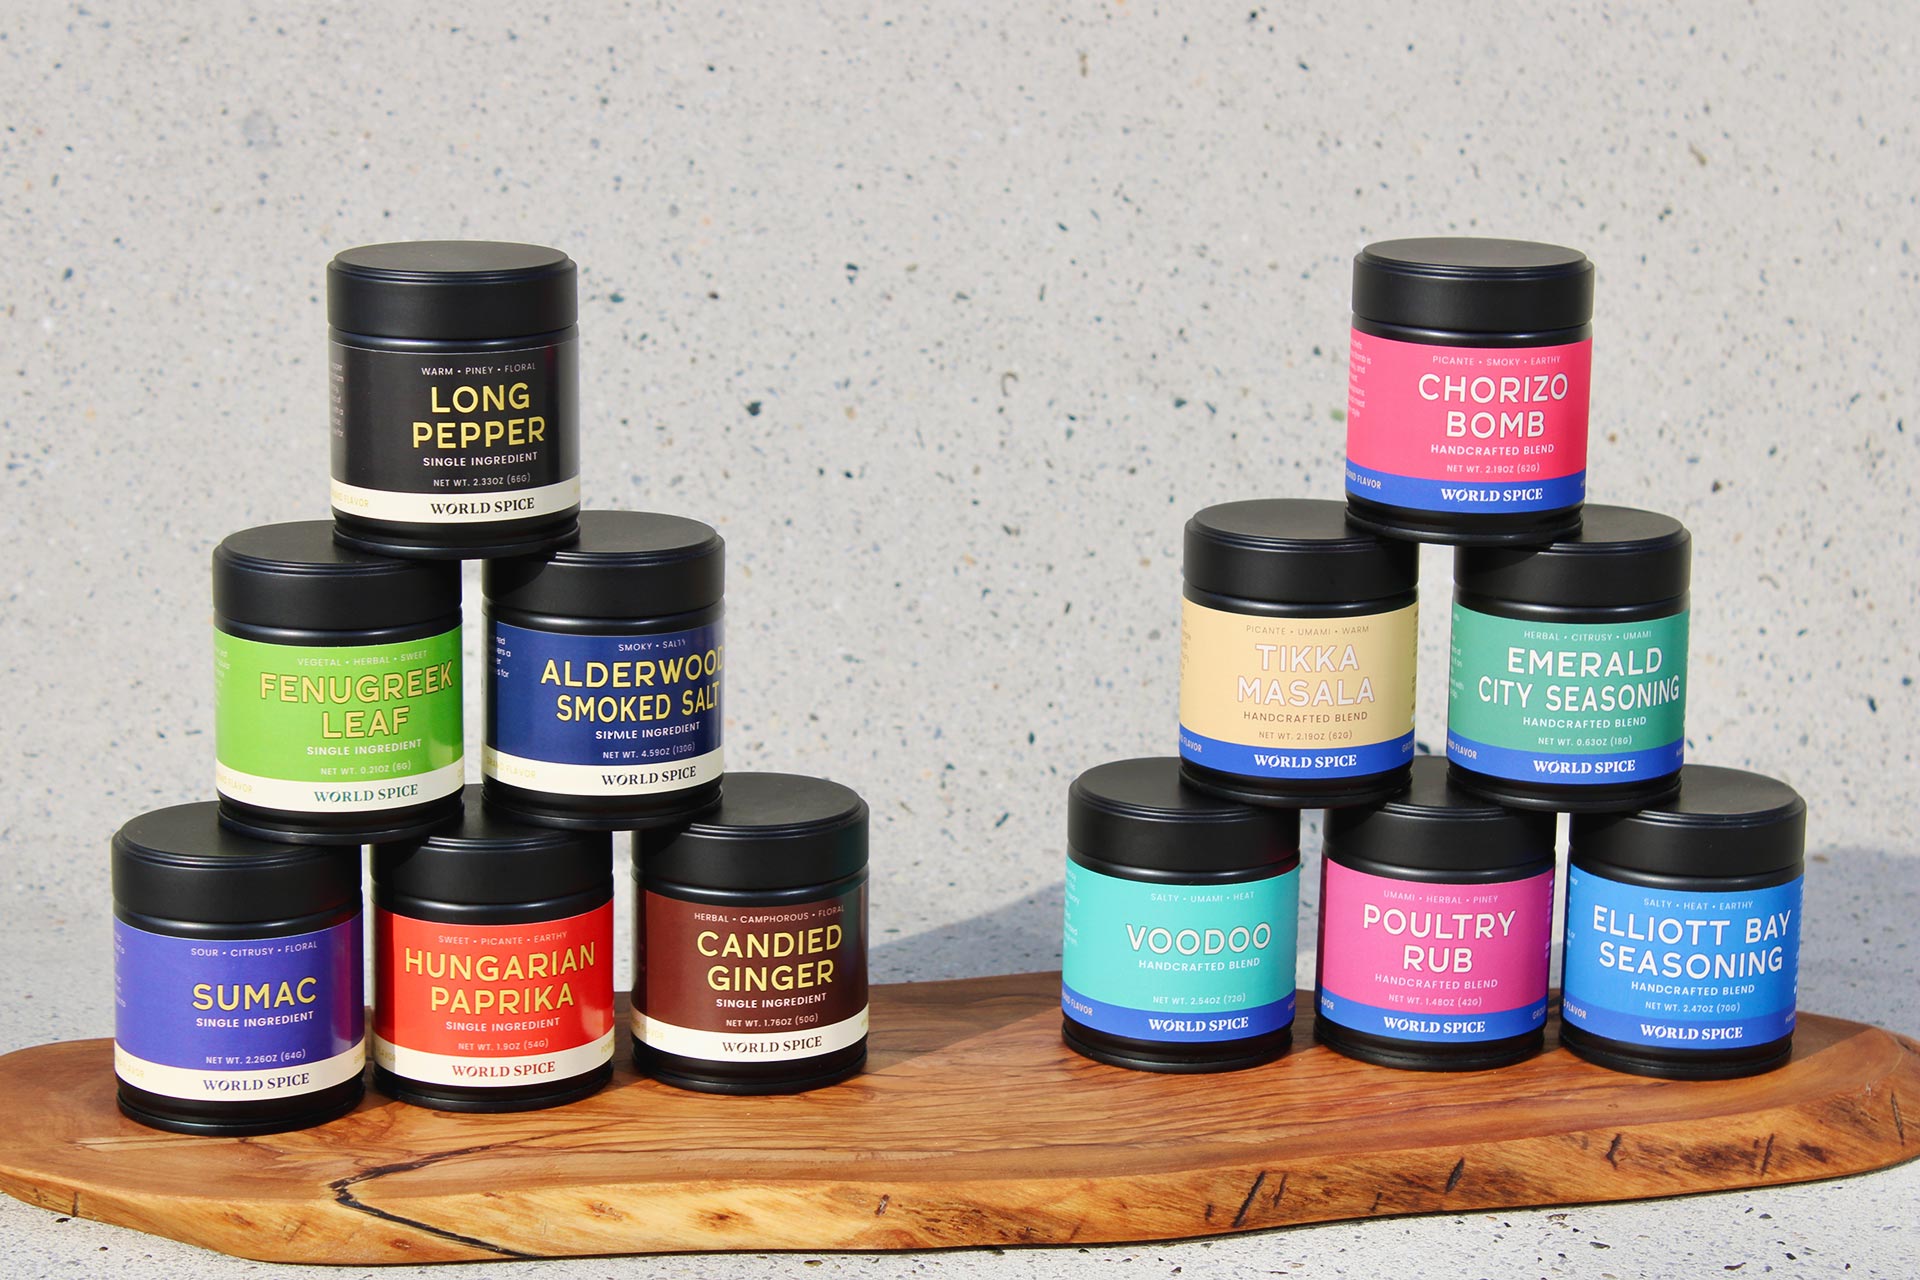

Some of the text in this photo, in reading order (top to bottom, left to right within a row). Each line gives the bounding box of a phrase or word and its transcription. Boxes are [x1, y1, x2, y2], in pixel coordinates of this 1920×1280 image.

[1432, 355, 1561, 366] PICANTE SMOKY EARTHY
[421, 362, 536, 376] WARM PINEY FLORAL
[1418, 372, 1569, 404] CHORIZO
[431, 382, 531, 414] LONG
[412, 416, 546, 449] PEPPER
[1446, 411, 1546, 439] BOMB
[1431, 444, 1555, 455] HANDCRAFTED BLEND
[423, 452, 538, 467] SINGLE INGREDIENT
[1447, 463, 1540, 473] NET WT. (62G)
[433, 473, 531, 487] NET WT. 2.33OZ (66G)
[1357, 474, 1381, 490] FLAVOR
[1503, 487, 1543, 501] SPICE
[494, 497, 535, 512] SPICE
[1246, 625, 1369, 636] PICANTE UMAMI WARM
[1524, 631, 1652, 641] HERBAL CITRUSY UMAMI
[618, 643, 652, 651] SMOKY
[297, 651, 428, 667] VEGETAL HERBAL SWEET
[1255, 643, 1360, 672] TIKKA
[1507, 646, 1663, 677] EMERALD
[540, 646, 724, 688] ALDERWOOD
[260, 660, 453, 704] FENUGREEK
[1237, 676, 1375, 707] MASALA
[1478, 675, 1680, 712] CITY SEASONING
[556, 683, 720, 723] SMOKED SALT
[322, 706, 410, 739] LEAF
[1244, 711, 1368, 723] HANDCRAFTED BLEND
[1523, 716, 1646, 729] HANDCRAFTED BLEND
[642, 721, 700, 738] INGREDIENT
[1259, 730, 1352, 741] NET WT. 2.19OZ (62G)
[307, 739, 422, 756] SINGLE INGREDIENT
[1538, 736, 1632, 747] NET WT. (18G)
[603, 748, 670, 759] NET WT. 4.59OZ
[1455, 744, 1477, 759] FLAVOR
[1317, 754, 1356, 768] SPICE
[1595, 760, 1635, 773] SPICE
[320, 767, 357, 776] NET WT.
[662, 766, 696, 782] SPICE
[378, 784, 418, 800] SPICE
[1151, 893, 1179, 902] SALTY
[1234, 891, 1254, 900] HEAT
[1383, 890, 1498, 904] UMAMI HERBAL PINEY
[1644, 898, 1754, 910] SALTY HEAT EARTHY
[694, 905, 845, 923] HERBAL CAMPHOROUS FLORAL
[1363, 903, 1517, 940] POULTRY
[1593, 904, 1731, 946] ELLIOTT
[1745, 909, 1791, 944] BAY
[438, 931, 567, 945] SWEET PICANTE EARTHY
[697, 924, 843, 958] CANDIED
[1126, 922, 1272, 956] VOODOO
[191, 941, 317, 957] SOUR CITRUSY FLORAL
[405, 942, 595, 981] HUNGARIAN
[1139, 958, 1260, 971] HANDCRAFTED BLEND
[1403, 945, 1473, 973] RUB
[1599, 942, 1783, 980] SEASONING
[707, 959, 834, 992] GINGER
[1375, 973, 1498, 989] HANDCRAFTED BLEND
[192, 976, 318, 1011] SUMAC
[1631, 981, 1755, 995] HANDCRAFTED BLEND
[431, 982, 574, 1014] PAPRIKA
[716, 992, 827, 1008] SINGLE INGREDIENT
[1153, 995, 1221, 1005] NET WT. 2.54OZ
[1389, 994, 1483, 1006] NET WT. 1.48OZ (42G)
[1070, 999, 1093, 1016] FLAVOR
[1645, 1001, 1740, 1013] NET WT. (70G)
[196, 1011, 314, 1027] SINGLE INGREDIENT
[446, 1017, 560, 1031] SINGLE INGREDIENT
[726, 1013, 819, 1027] NET WT. 1.76OZ (50G)
[1209, 1016, 1249, 1031] SPICE
[1444, 1020, 1485, 1033] SPICE
[1701, 1027, 1743, 1040] SPICE
[458, 1042, 474, 1050] NET
[497, 1042, 520, 1050] 1.9OZ
[524, 1038, 549, 1050] (54G)
[783, 1036, 822, 1051] SPICE
[206, 1049, 306, 1064] NET WT. 2.26OZ (64G)
[514, 1061, 556, 1076] SPICE
[267, 1072, 310, 1089] SPICE
